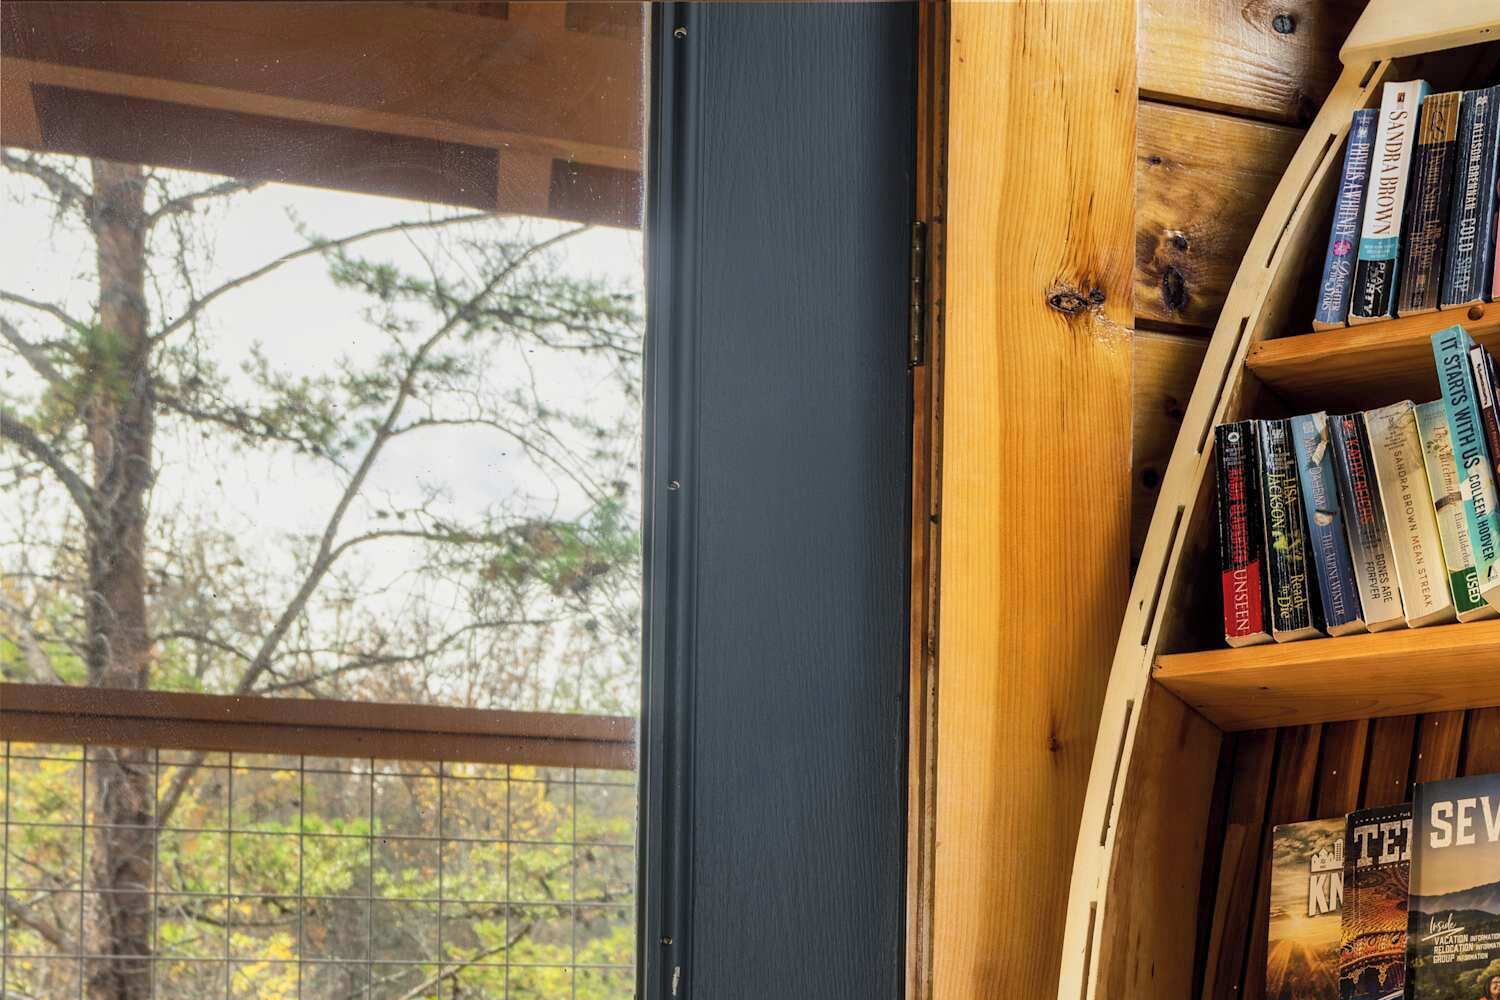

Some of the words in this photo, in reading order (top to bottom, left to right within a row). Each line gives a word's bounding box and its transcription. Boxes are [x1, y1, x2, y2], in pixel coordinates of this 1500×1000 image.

[1345, 142, 1370, 182] PHYLLIS
[1381, 110, 1408, 177] SANDRA
[1470, 123, 1487, 165] ALLISON
[1373, 176, 1400, 235] BROWN
[1464, 165, 1481, 210] BRENNAN
[1335, 190, 1362, 238] WHITNEY
[1458, 217, 1476, 252] COLD
[1321, 279, 1335, 312] STARS
[1333, 259, 1350, 311] DAUGHTER
[1374, 262, 1386, 293] PLAY
[1440, 336, 1457, 351] IT
[1444, 354, 1468, 407] STARTS
[1453, 406, 1474, 450] WITH
[1344, 437, 1365, 480] KATHY
[1393, 451, 1408, 493] SANDRA
[1462, 450, 1480, 470] US
[1266, 470, 1288, 533] JACKSON
[1285, 477, 1297, 506] LISA
[1310, 466, 1327, 513] DAHEIM
[1402, 494, 1417, 531] BROWN
[1468, 471, 1486, 516] COLLEEN
[1477, 515, 1494, 561] HOOVER
[1411, 533, 1425, 564] MEAN
[1456, 527, 1473, 567] Hilderbra
[1289, 572, 1306, 617] Ready
[1320, 533, 1333, 551] THE
[1328, 584, 1344, 616] WINTER
[1365, 561, 1380, 600] FOREVER
[1374, 552, 1389, 581] BONES
[1382, 582, 1393, 603] ARE
[1417, 566, 1432, 608] STREAK
[1464, 572, 1480, 603] USED
[1233, 568, 1249, 633] UNSEEN
[1275, 593, 1291, 620] Die
[1429, 913, 1456, 934] Inside
[1434, 934, 1468, 946] VACATION
[1433, 955, 1455, 964] GROUP
[1434, 943, 1473, 954] RELOCATION
